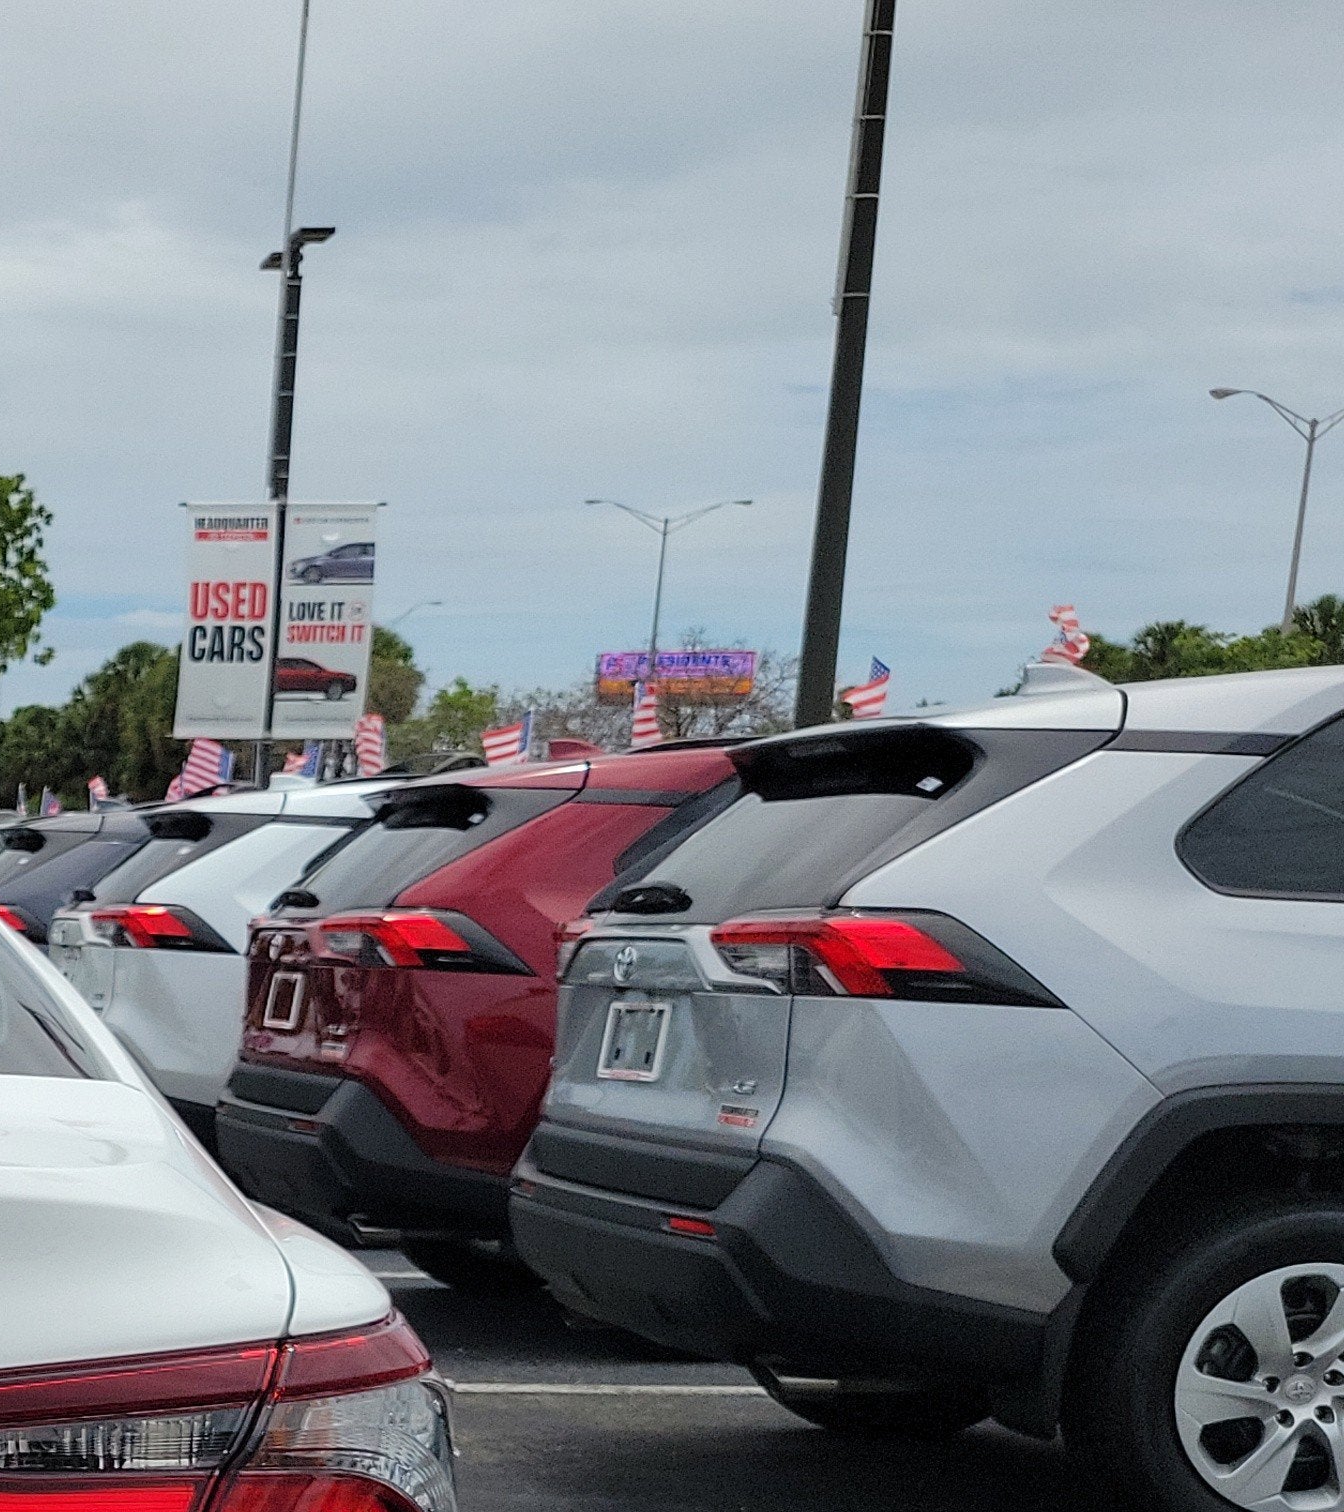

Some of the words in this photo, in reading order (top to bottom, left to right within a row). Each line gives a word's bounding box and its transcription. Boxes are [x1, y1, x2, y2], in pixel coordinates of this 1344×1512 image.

[190, 582, 267, 621] USED
[288, 601, 325, 621] LOVE
[330, 601, 345, 621] IT
[189, 625, 265, 662] CARS
[287, 624, 346, 644] SWITCH
[350, 624, 365, 644] IT
